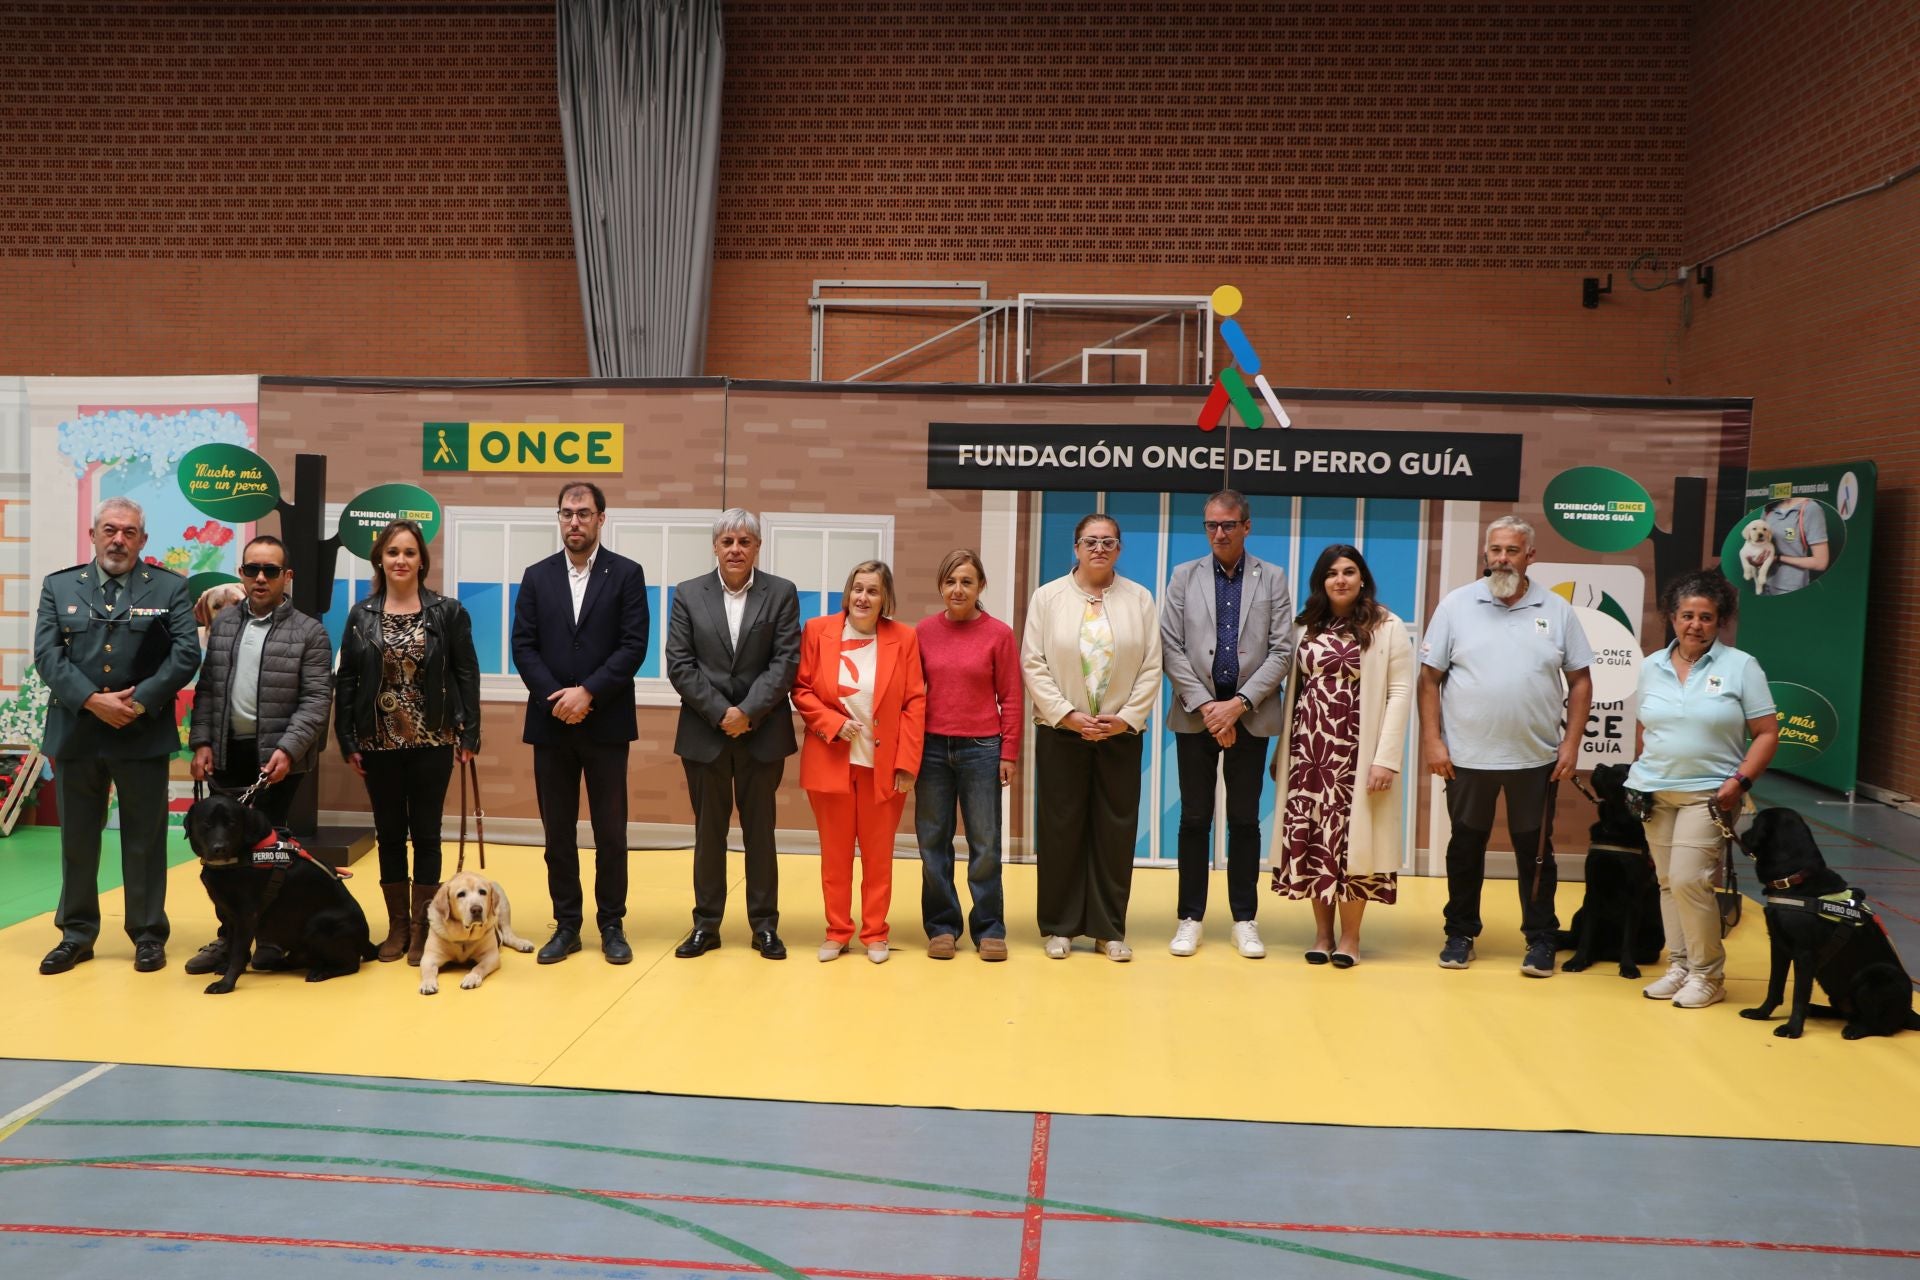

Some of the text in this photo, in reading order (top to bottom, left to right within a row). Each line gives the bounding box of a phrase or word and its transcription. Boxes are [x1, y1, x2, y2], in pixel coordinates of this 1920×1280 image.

[480, 431, 612, 464] ONCE
[958, 440, 1473, 477] FUNDACIÓN ONCE DEL PERRO GUÍA
[195, 463, 263, 480] Mucho más
[189, 480, 268, 496] que un perro
[1554, 502, 1605, 511] EXHIBICIÓN
[350, 510, 396, 519] EXHIBICIÓN
[1563, 512, 1634, 522] DE PERROS GUÍA
[358, 519, 369, 527] DE
[1602, 649, 1632, 658] ONCE
[1607, 657, 1631, 666] GUÍA
[1788, 715, 1816, 729] más
[1778, 726, 1819, 744] perro
[1583, 739, 1622, 754] GUÍA
[253, 852, 290, 860] PERRO GUIA
[1823, 903, 1845, 914] PERRO
